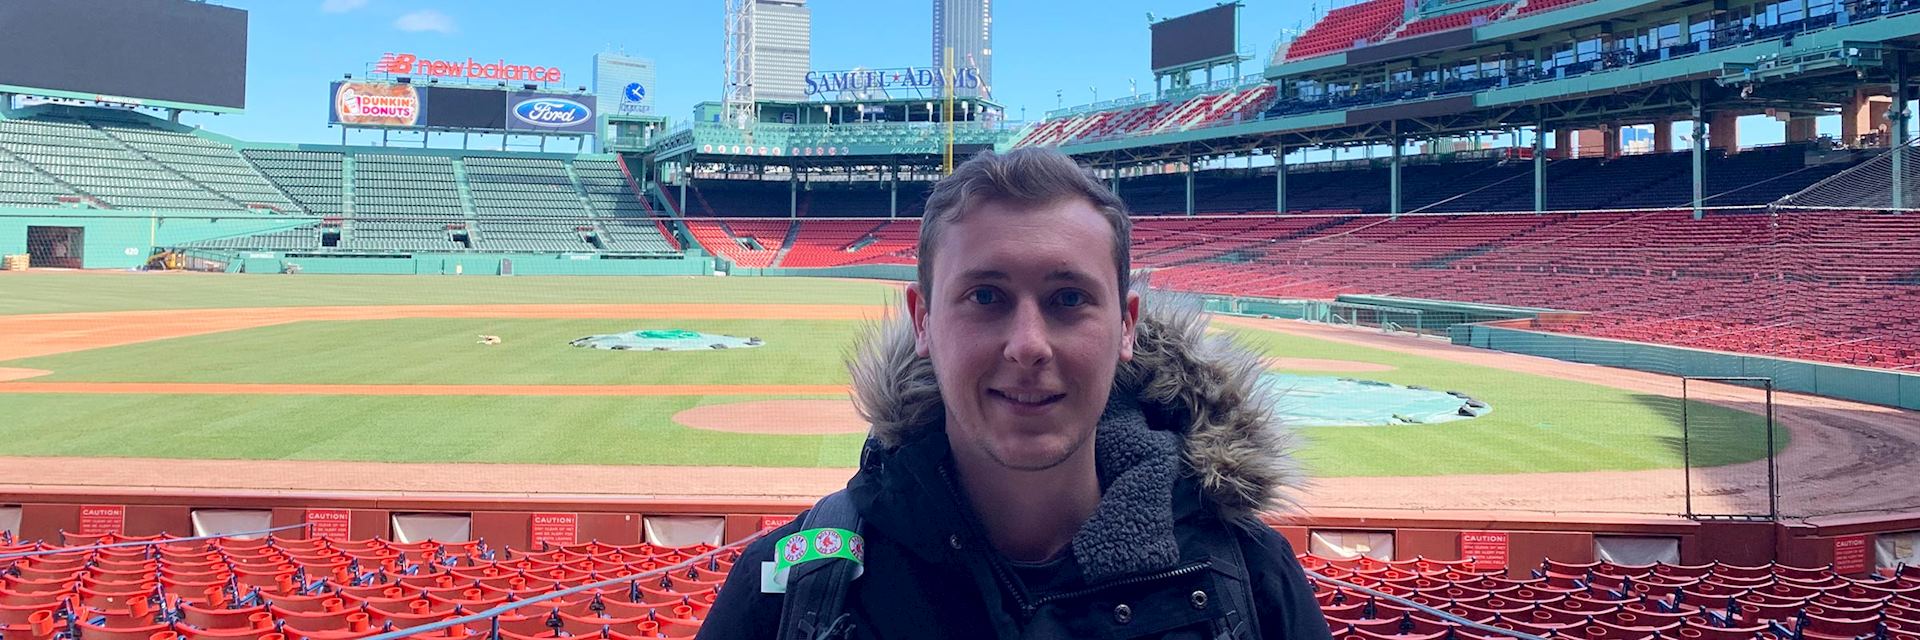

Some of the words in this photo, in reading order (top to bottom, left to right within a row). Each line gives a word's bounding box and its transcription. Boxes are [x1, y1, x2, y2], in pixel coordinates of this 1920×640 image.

[418, 59, 465, 78] new
[467, 57, 561, 82] balance
[804, 70, 890, 96] SAMUEL
[901, 66, 980, 89] ADAMS
[361, 95, 414, 107] DUNKIN'
[361, 105, 411, 117] DONUTS
[528, 99, 574, 122] Ford
[309, 512, 348, 520] CAUTION!
